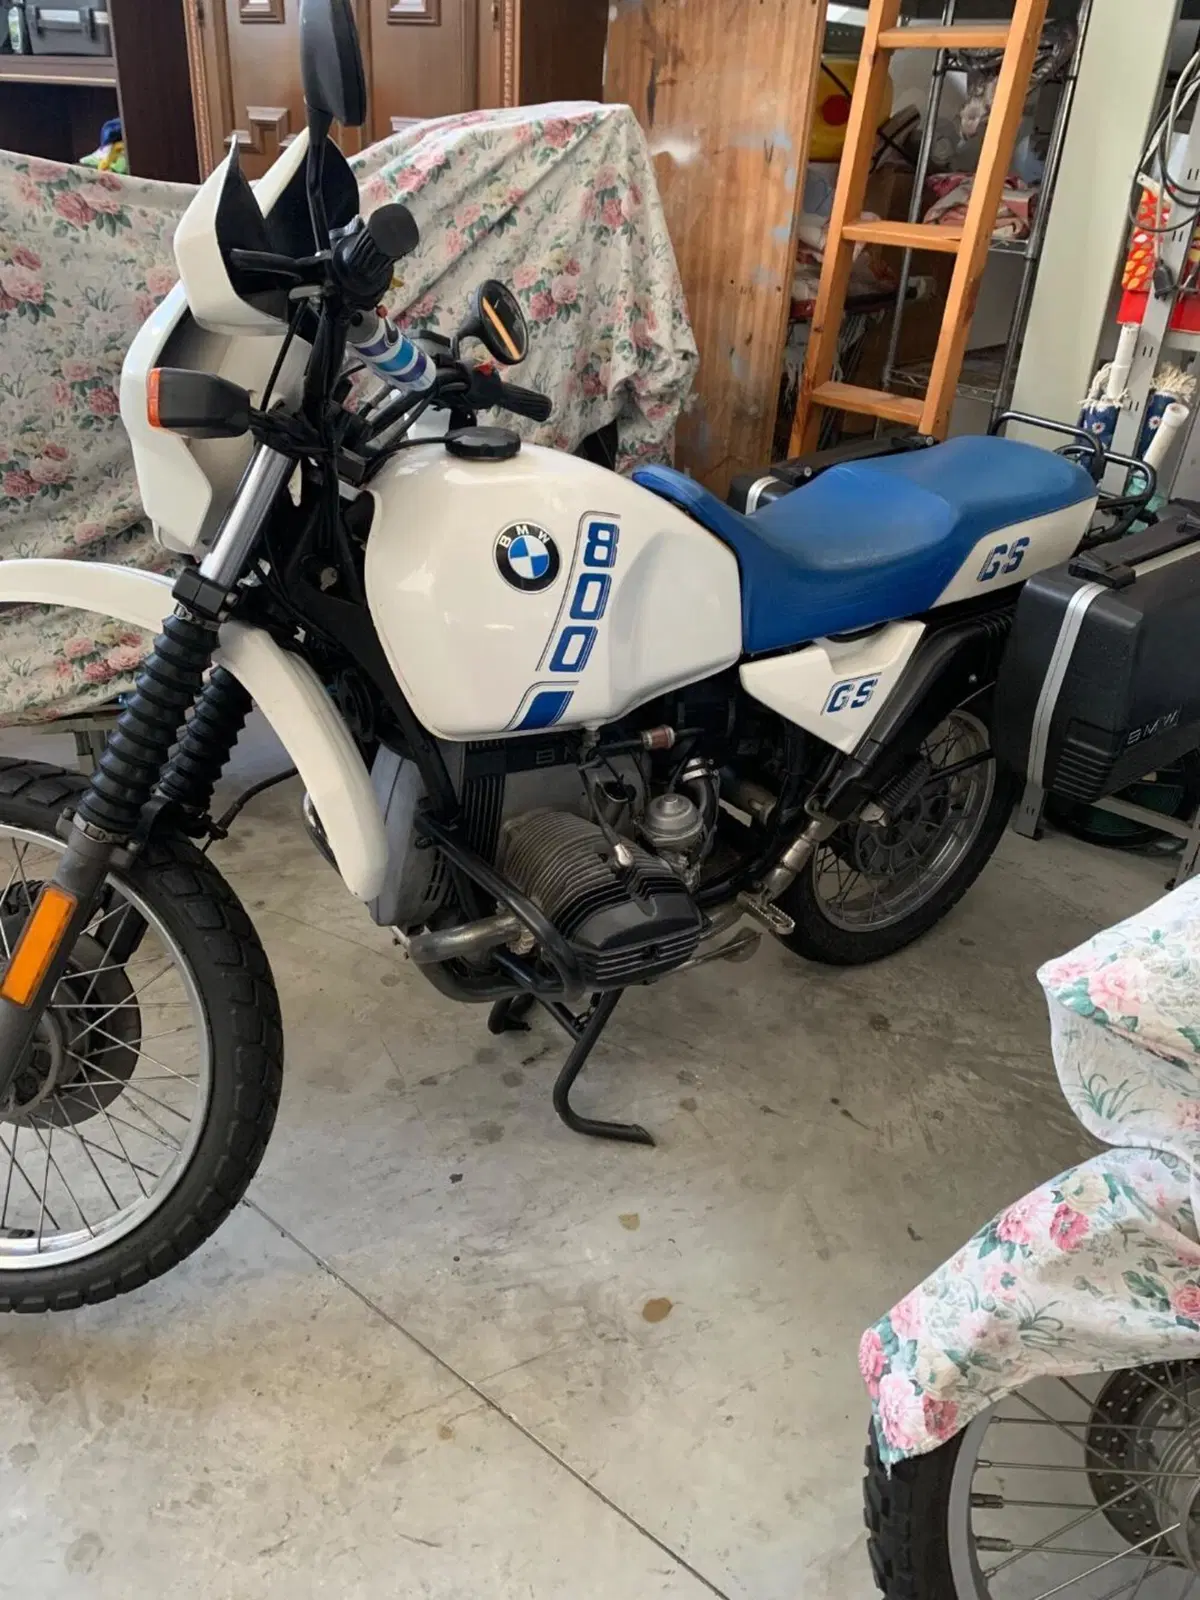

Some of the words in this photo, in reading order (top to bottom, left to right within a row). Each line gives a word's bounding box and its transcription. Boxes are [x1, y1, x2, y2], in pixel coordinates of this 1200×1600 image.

[499, 525, 550, 548] BMW
[976, 537, 1030, 582] GS
[549, 522, 620, 672] 800
[827, 679, 878, 713] GS
[1127, 709, 1179, 745] BMW
